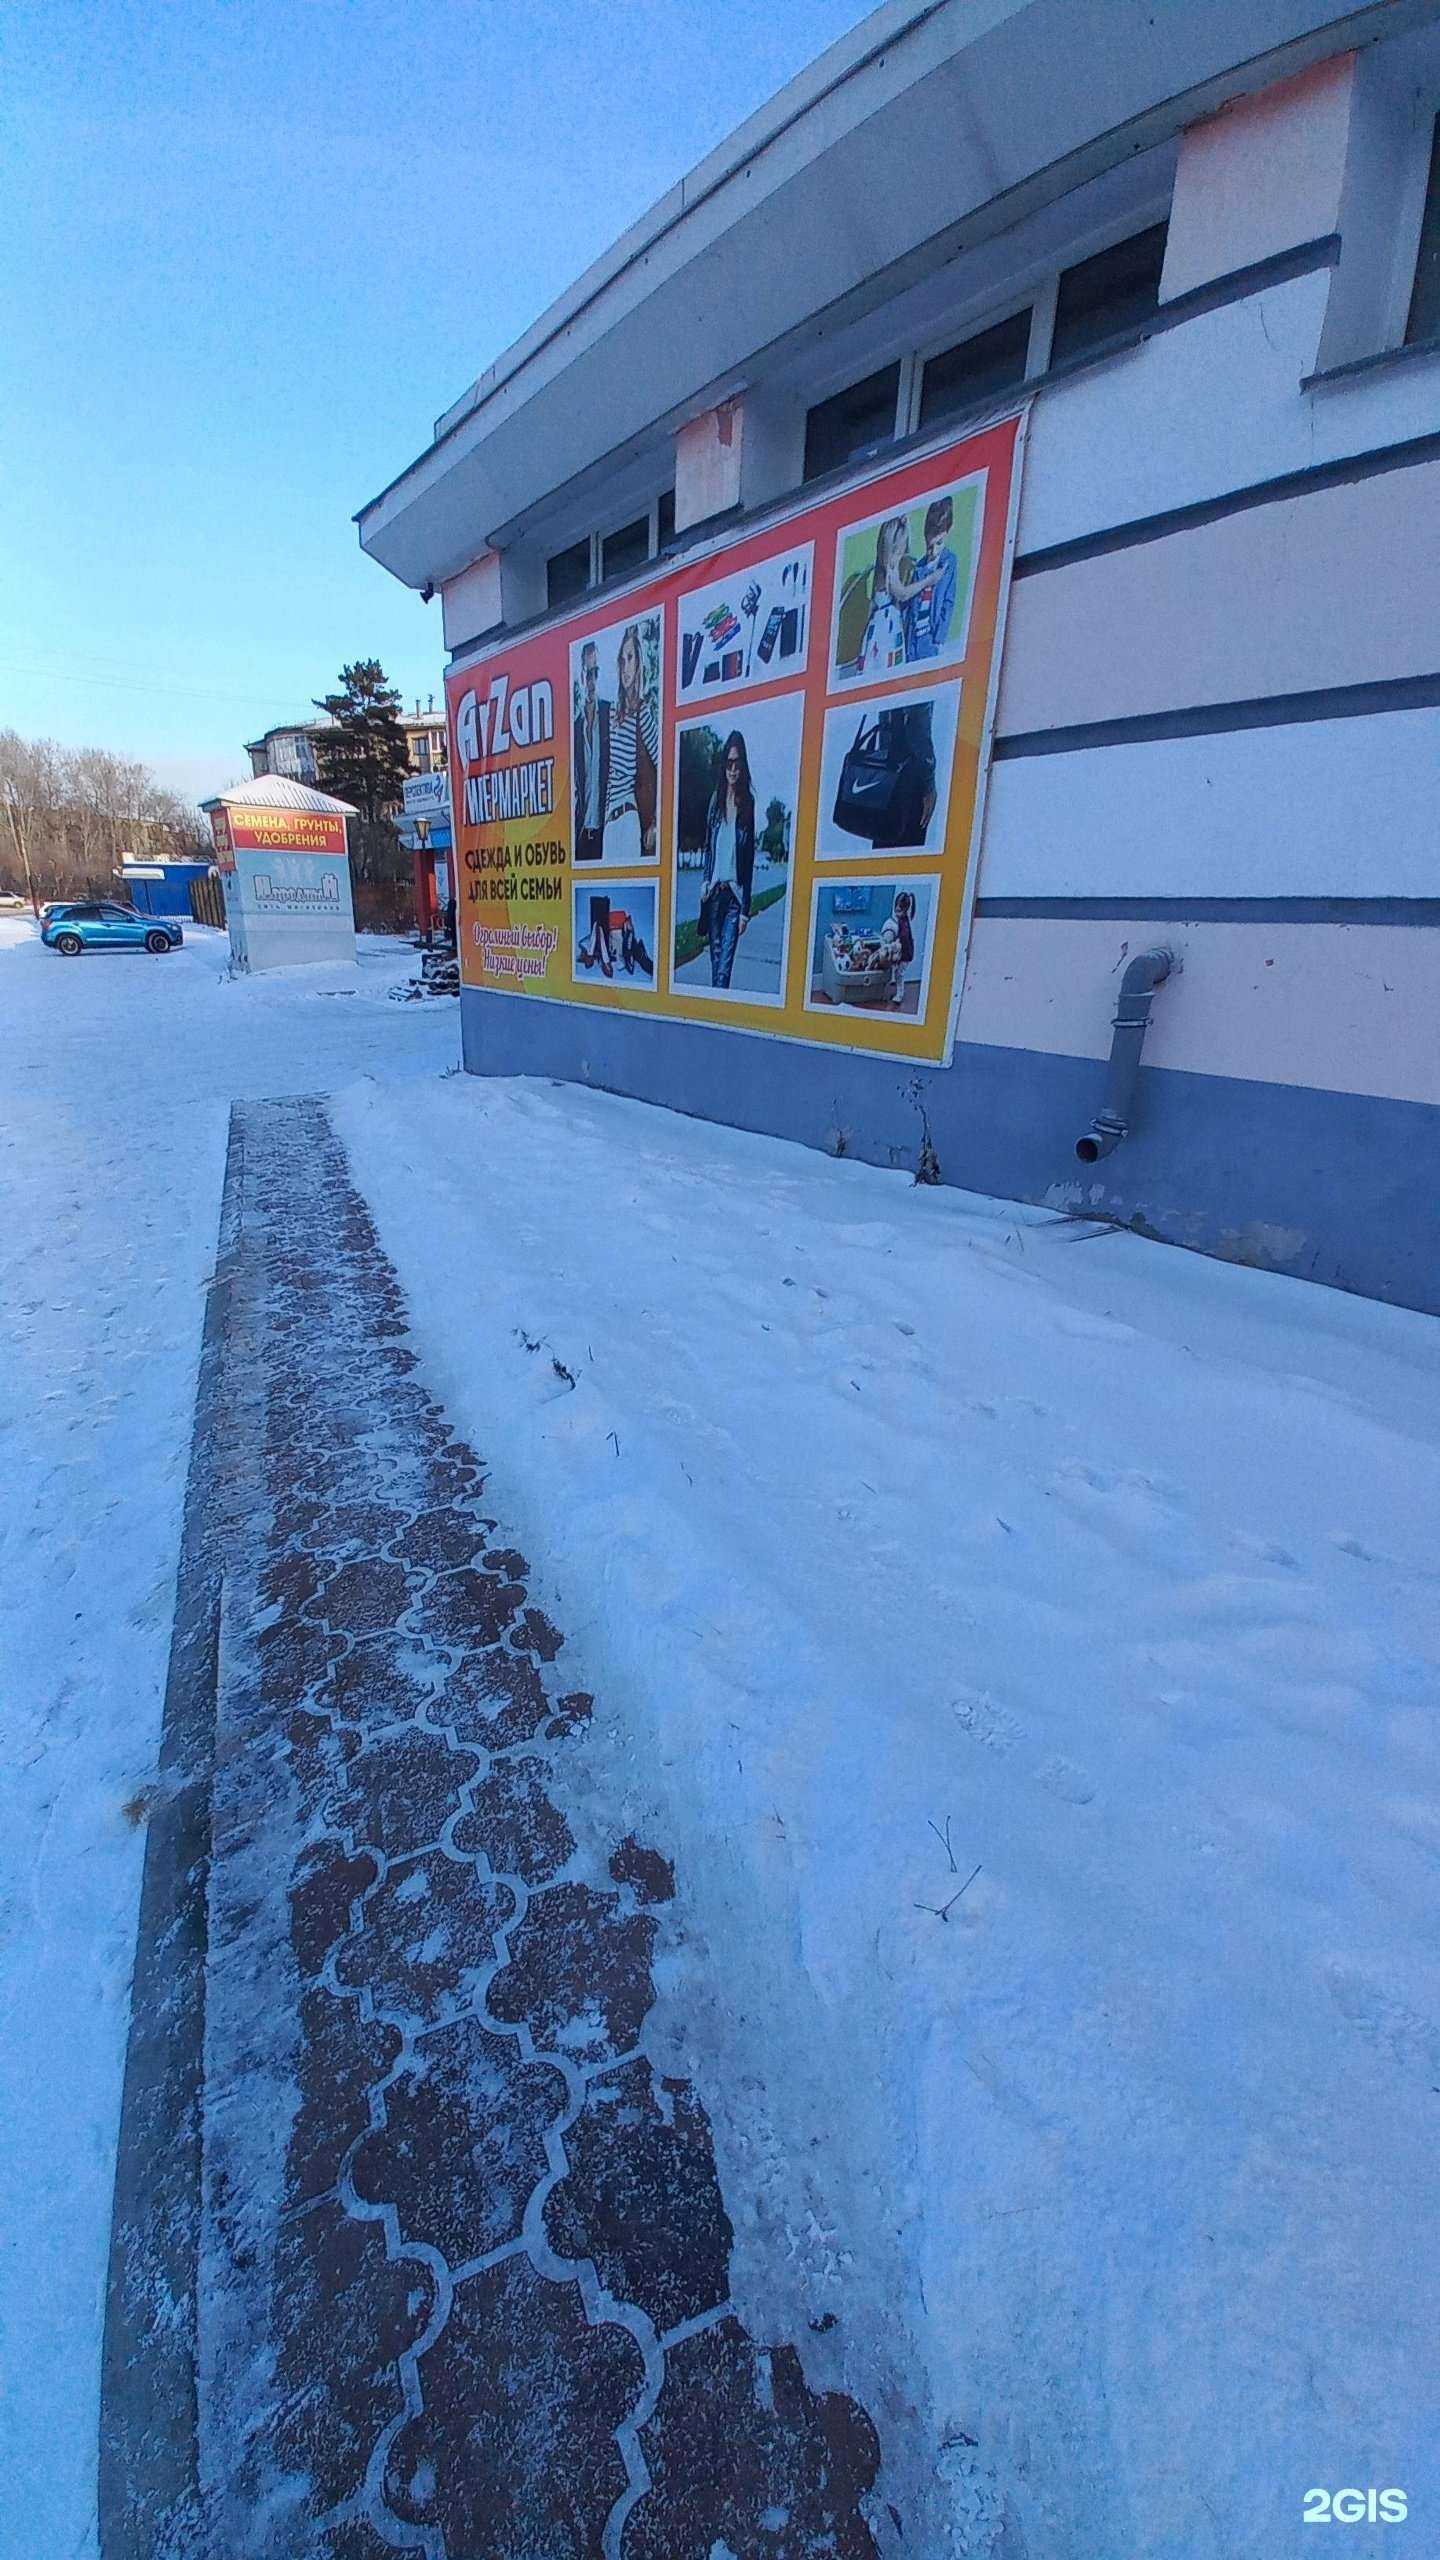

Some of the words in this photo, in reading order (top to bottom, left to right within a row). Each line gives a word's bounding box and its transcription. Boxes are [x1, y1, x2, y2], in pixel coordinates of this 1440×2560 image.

[233, 813, 290, 831] СЕМЕНА,
[293, 817, 342, 835] ГРУНТЫ,
[254, 830, 327, 847] УДОБРЕНИЯ
[514, 844, 522, 867] И
[524, 839, 566, 867] ОБУВЬ
[490, 872, 518, 901] ВСЕЙ
[520, 876, 562, 901] СЕМЬИ
